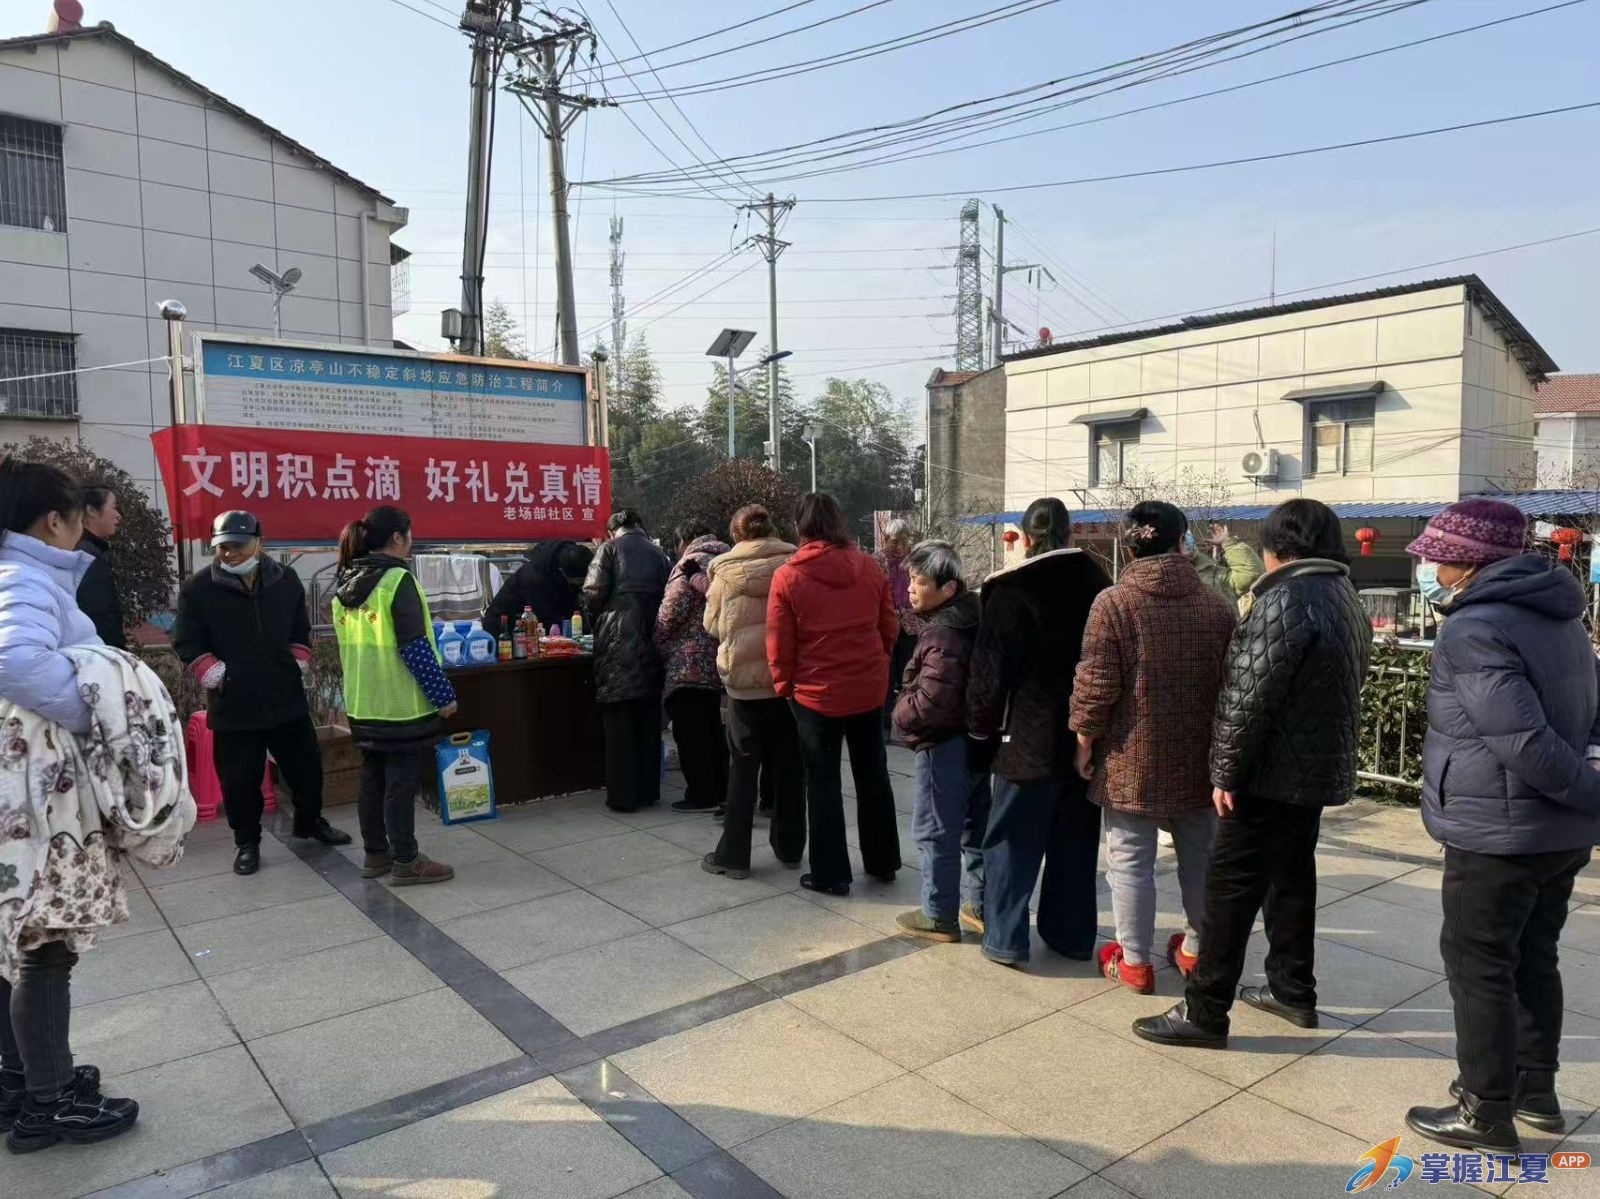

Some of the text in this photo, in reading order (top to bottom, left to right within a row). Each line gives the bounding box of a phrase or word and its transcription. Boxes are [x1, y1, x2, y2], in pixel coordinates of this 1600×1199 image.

[227, 353, 564, 393] 江夏区凉亭山不稳定斜坡应急防治工程简介
[182, 446, 602, 506] 文明积点滴 好礼兑真情
[503, 506, 595, 522] 老场部社区 宣
